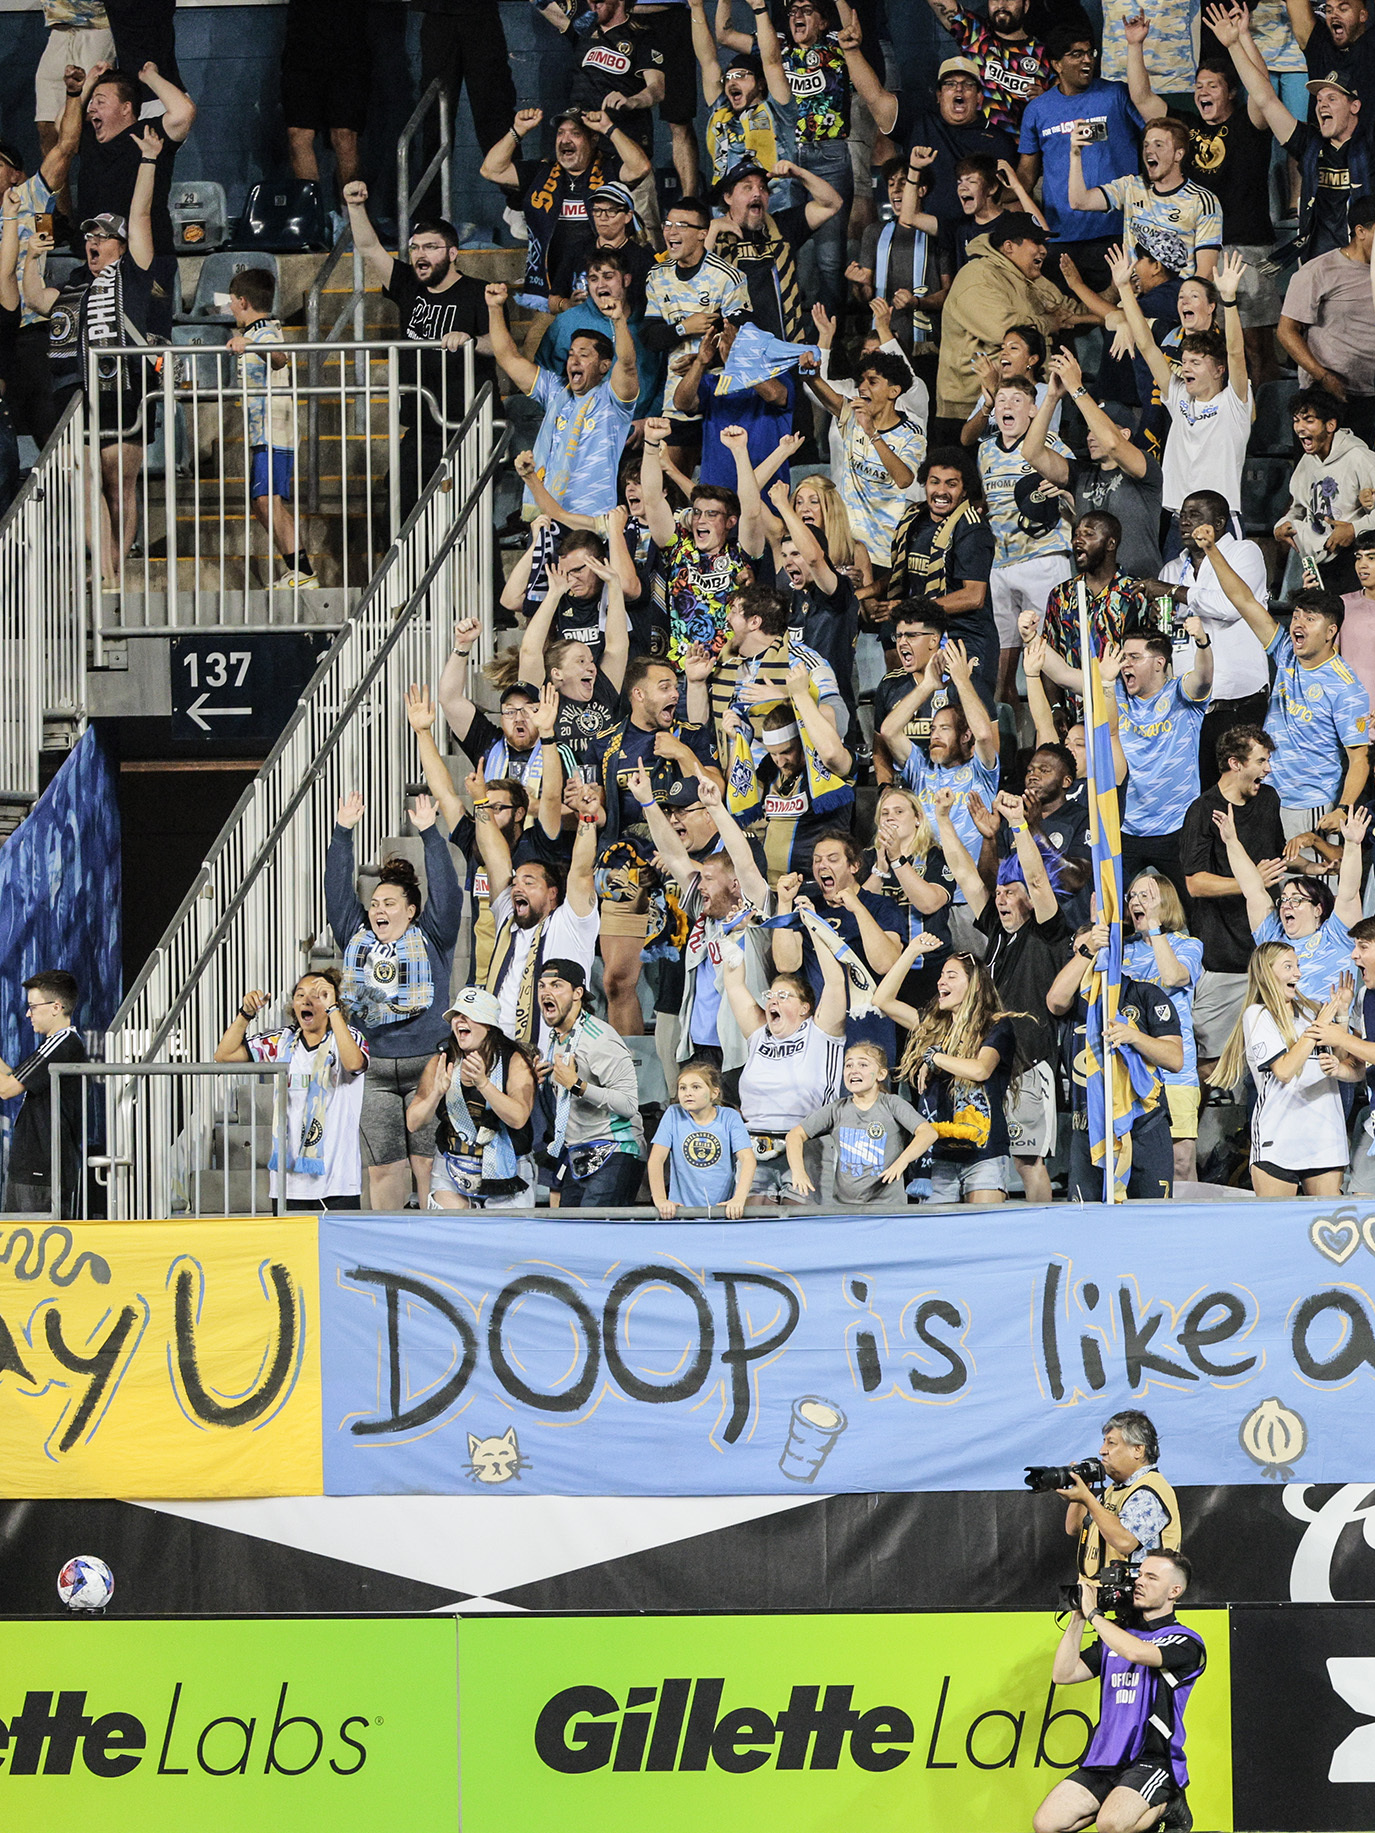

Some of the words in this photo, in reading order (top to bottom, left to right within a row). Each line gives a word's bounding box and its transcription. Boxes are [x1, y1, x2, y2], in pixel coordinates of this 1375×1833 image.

[588, 49, 627, 70] BIMBO
[789, 74, 822, 95] IMBO
[183, 651, 252, 688] 137
[560, 726, 571, 736] 20
[758, 1041, 804, 1058] BIMBO
[175, 1263, 295, 1428] U
[346, 1264, 800, 1444] DOOP
[851, 1280, 967, 1394] is
[1042, 1261, 1258, 1400] like
[534, 1677, 915, 1774] Gillette
[925, 1675, 1097, 1770] Lab
